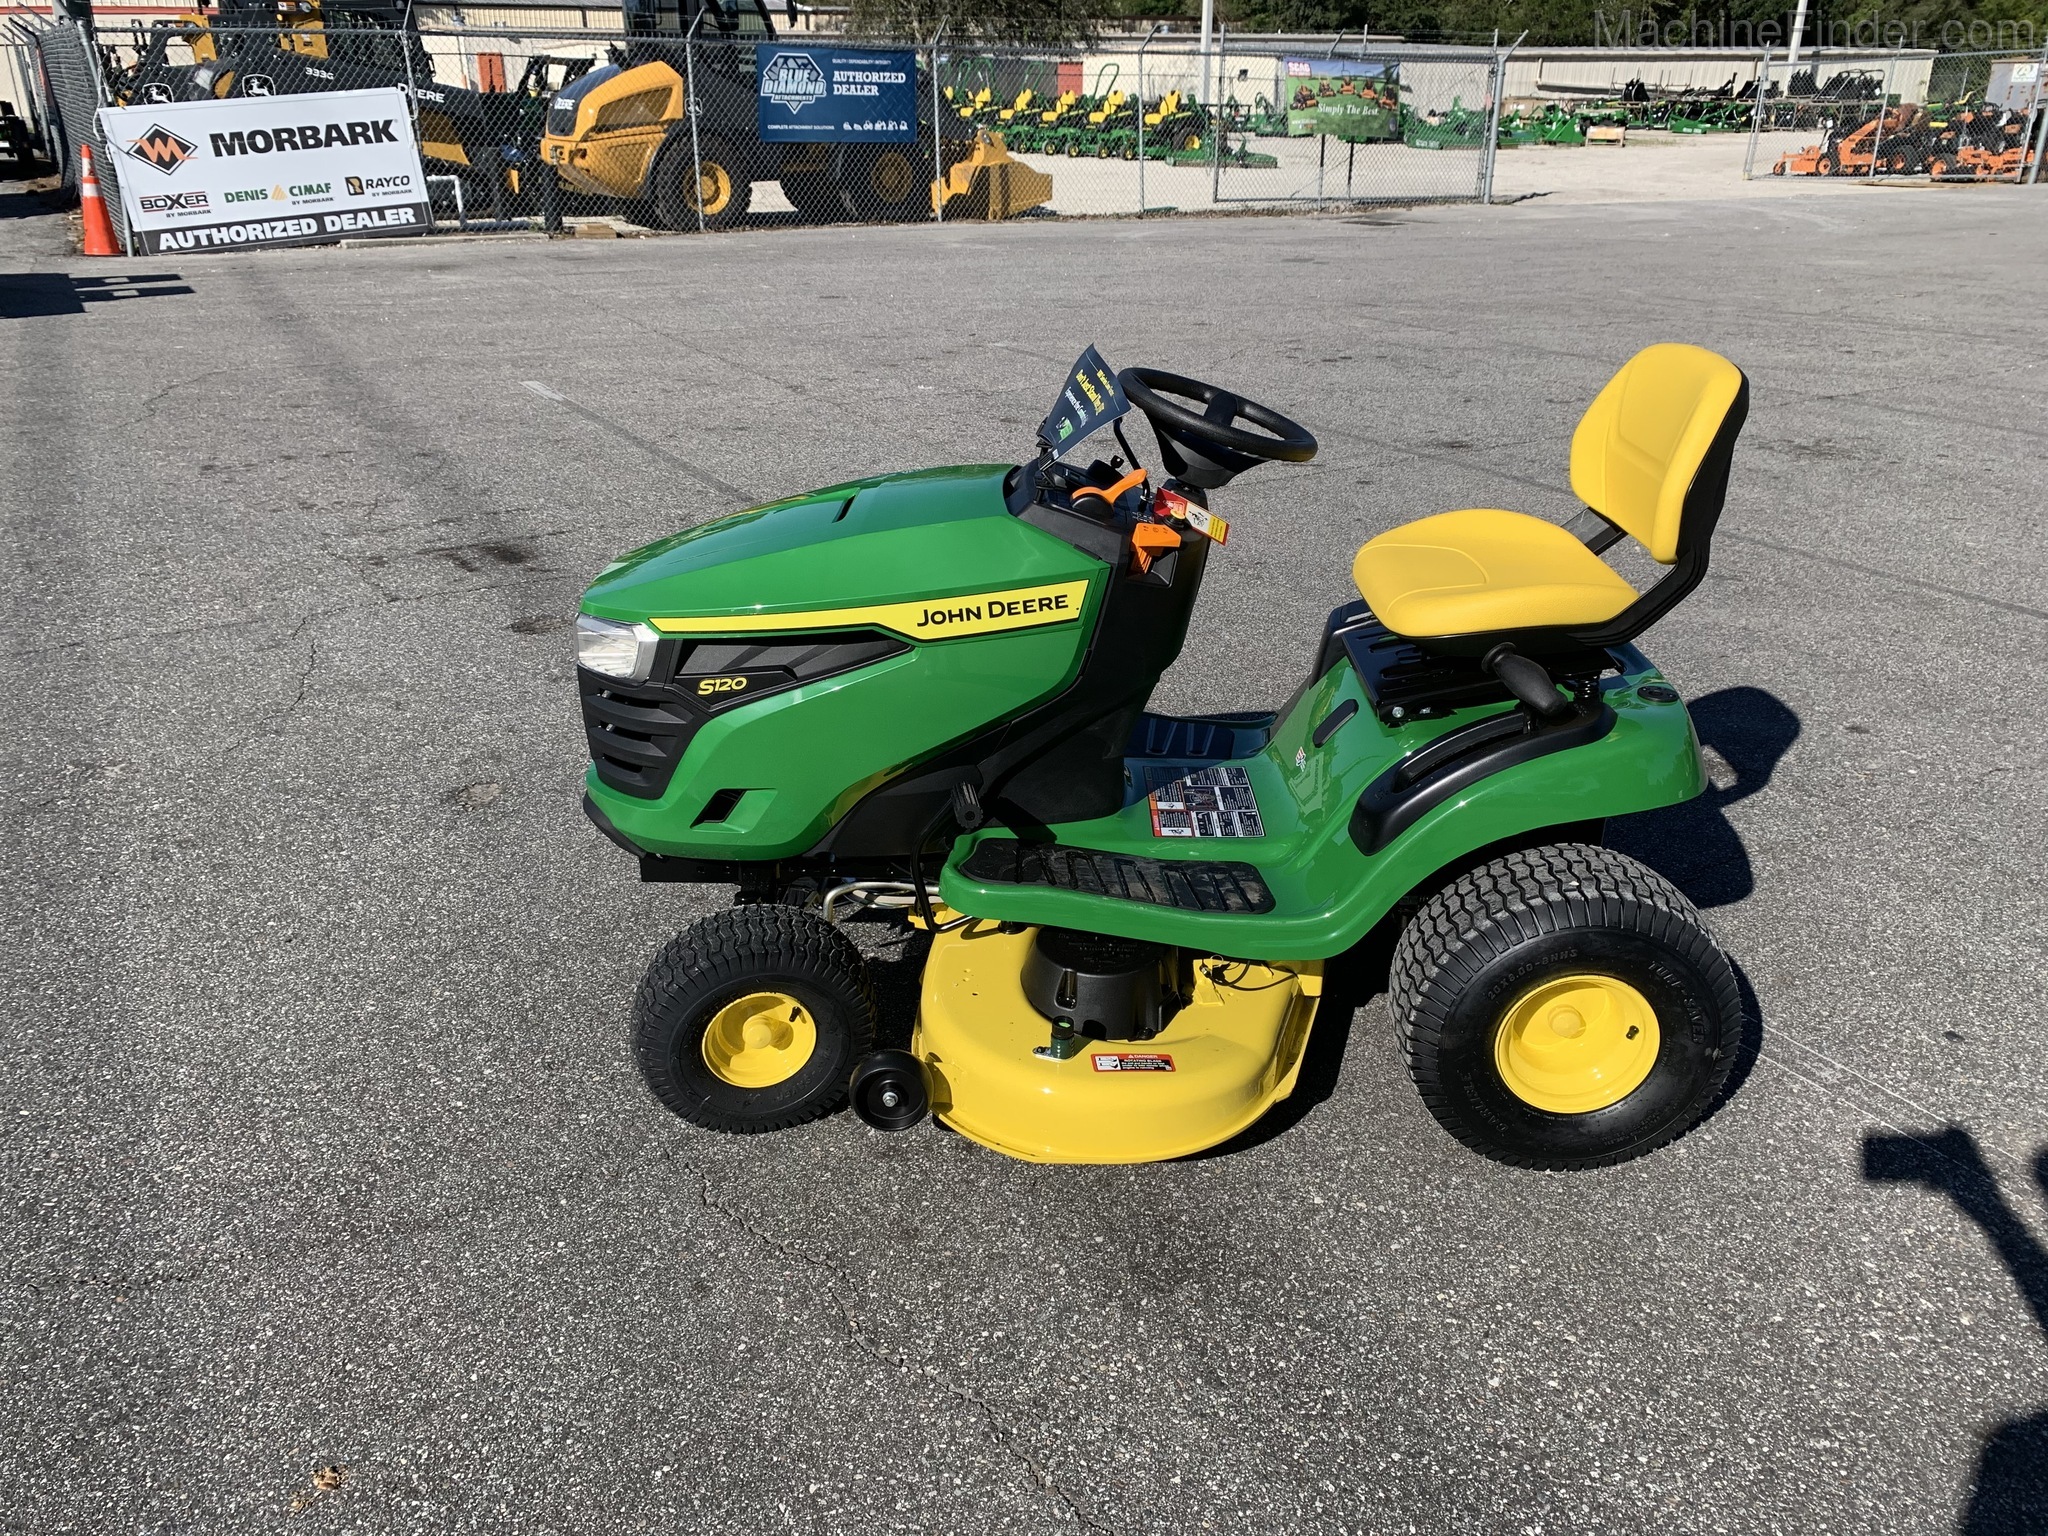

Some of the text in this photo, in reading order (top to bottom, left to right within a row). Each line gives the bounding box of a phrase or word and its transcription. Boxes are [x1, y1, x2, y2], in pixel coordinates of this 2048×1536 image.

[305, 67, 334, 80] 333G
[778, 68, 811, 83] BLUE
[833, 70, 906, 83] AUTHORIZED
[763, 80, 825, 95] DIAMOND
[833, 84, 879, 96] DEALER
[1318, 103, 1344, 116] Simply
[1347, 104, 1361, 115] The
[209, 119, 399, 158] MORBARK
[365, 175, 410, 190] RAYCO
[224, 182, 332, 203] DENIS CIMAF
[381, 188, 413, 196] MORBARK
[140, 192, 209, 210] BOXER
[302, 196, 334, 204] MORBARK
[177, 209, 212, 217] MORBARK
[159, 207, 417, 250] AUTHORIZED DEALER
[916, 594, 1069, 627] JOHN DEERE
[697, 676, 748, 696] S120
